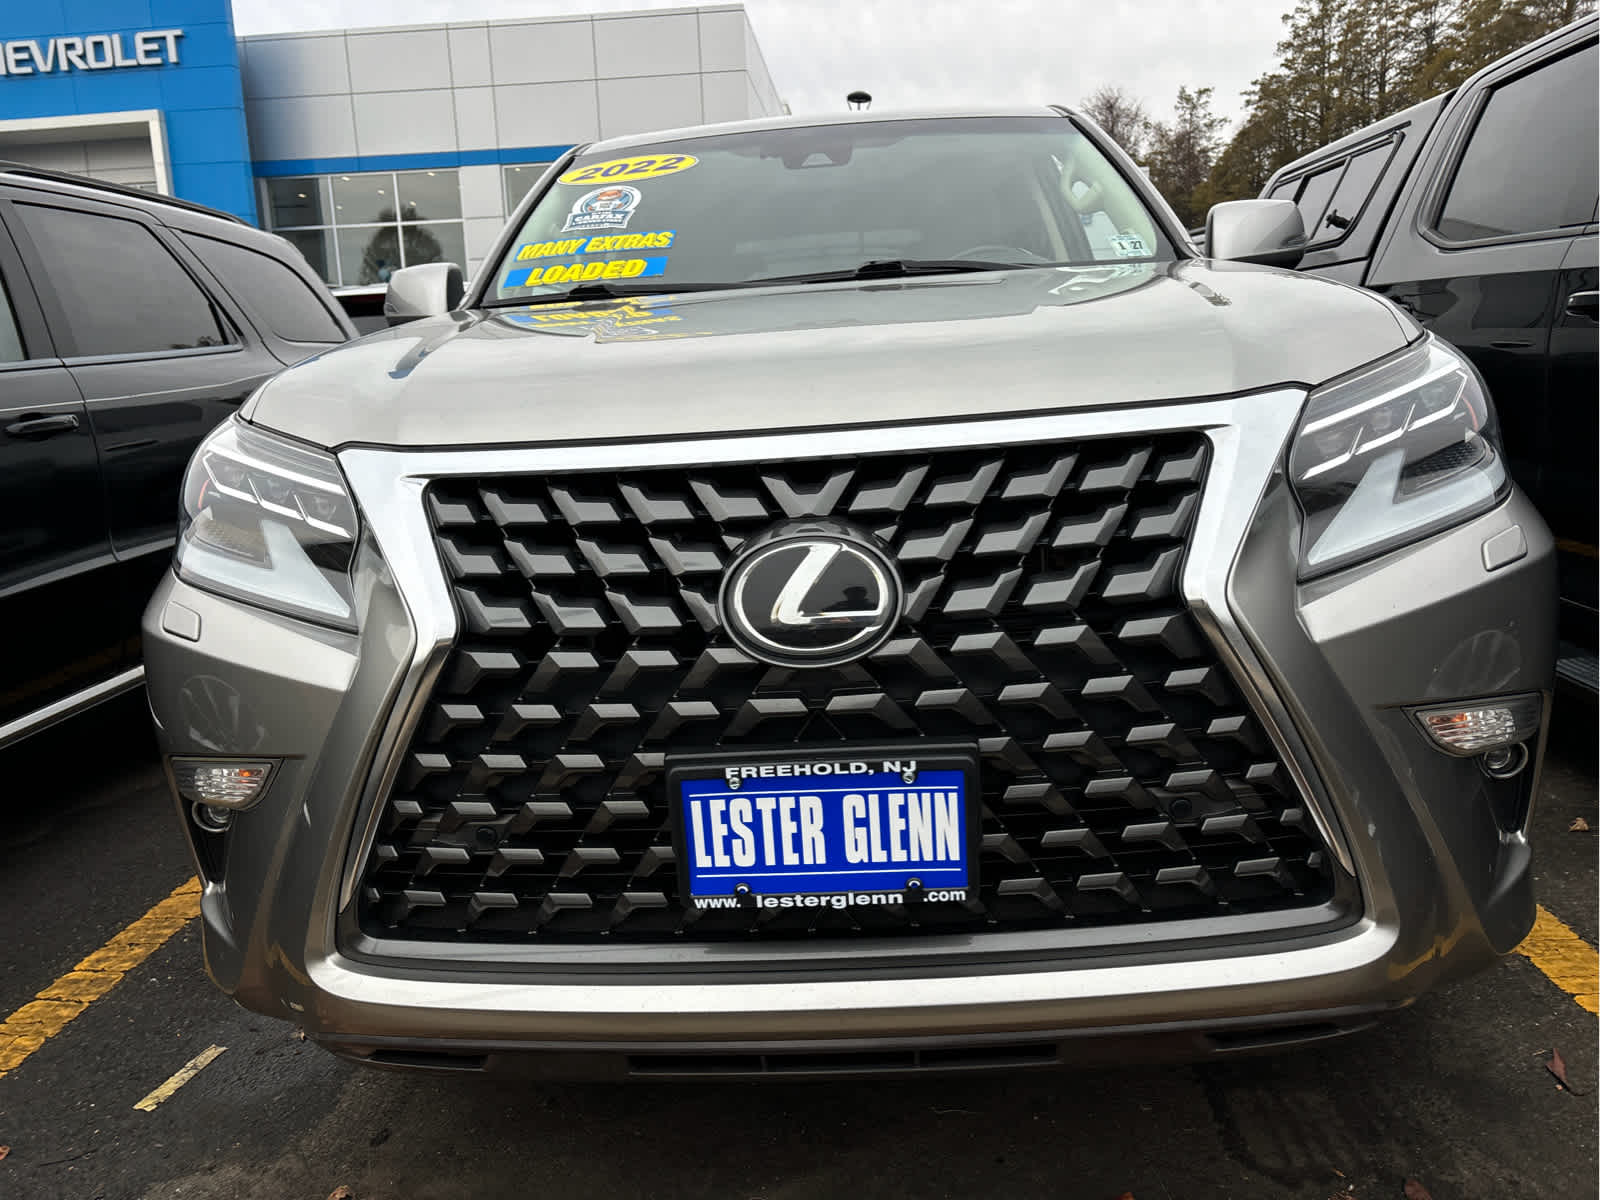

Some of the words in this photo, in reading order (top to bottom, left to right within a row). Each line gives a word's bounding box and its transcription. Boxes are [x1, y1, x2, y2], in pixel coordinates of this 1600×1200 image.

[0, 29, 183, 76] EVROLET
[572, 156, 685, 181] 2022
[575, 212, 625, 220] CARFAX
[517, 238, 587, 261] MANY
[586, 231, 673, 249] EXTRAS
[525, 258, 647, 286] LOADED
[725, 762, 874, 779] FREEHOLD,
[883, 760, 917, 773] NJ
[690, 796, 827, 868] LESTER
[842, 792, 961, 864] GLENN
[694, 896, 742, 909] www.
[755, 891, 904, 909] lesterglenn
[923, 889, 966, 903] .com
